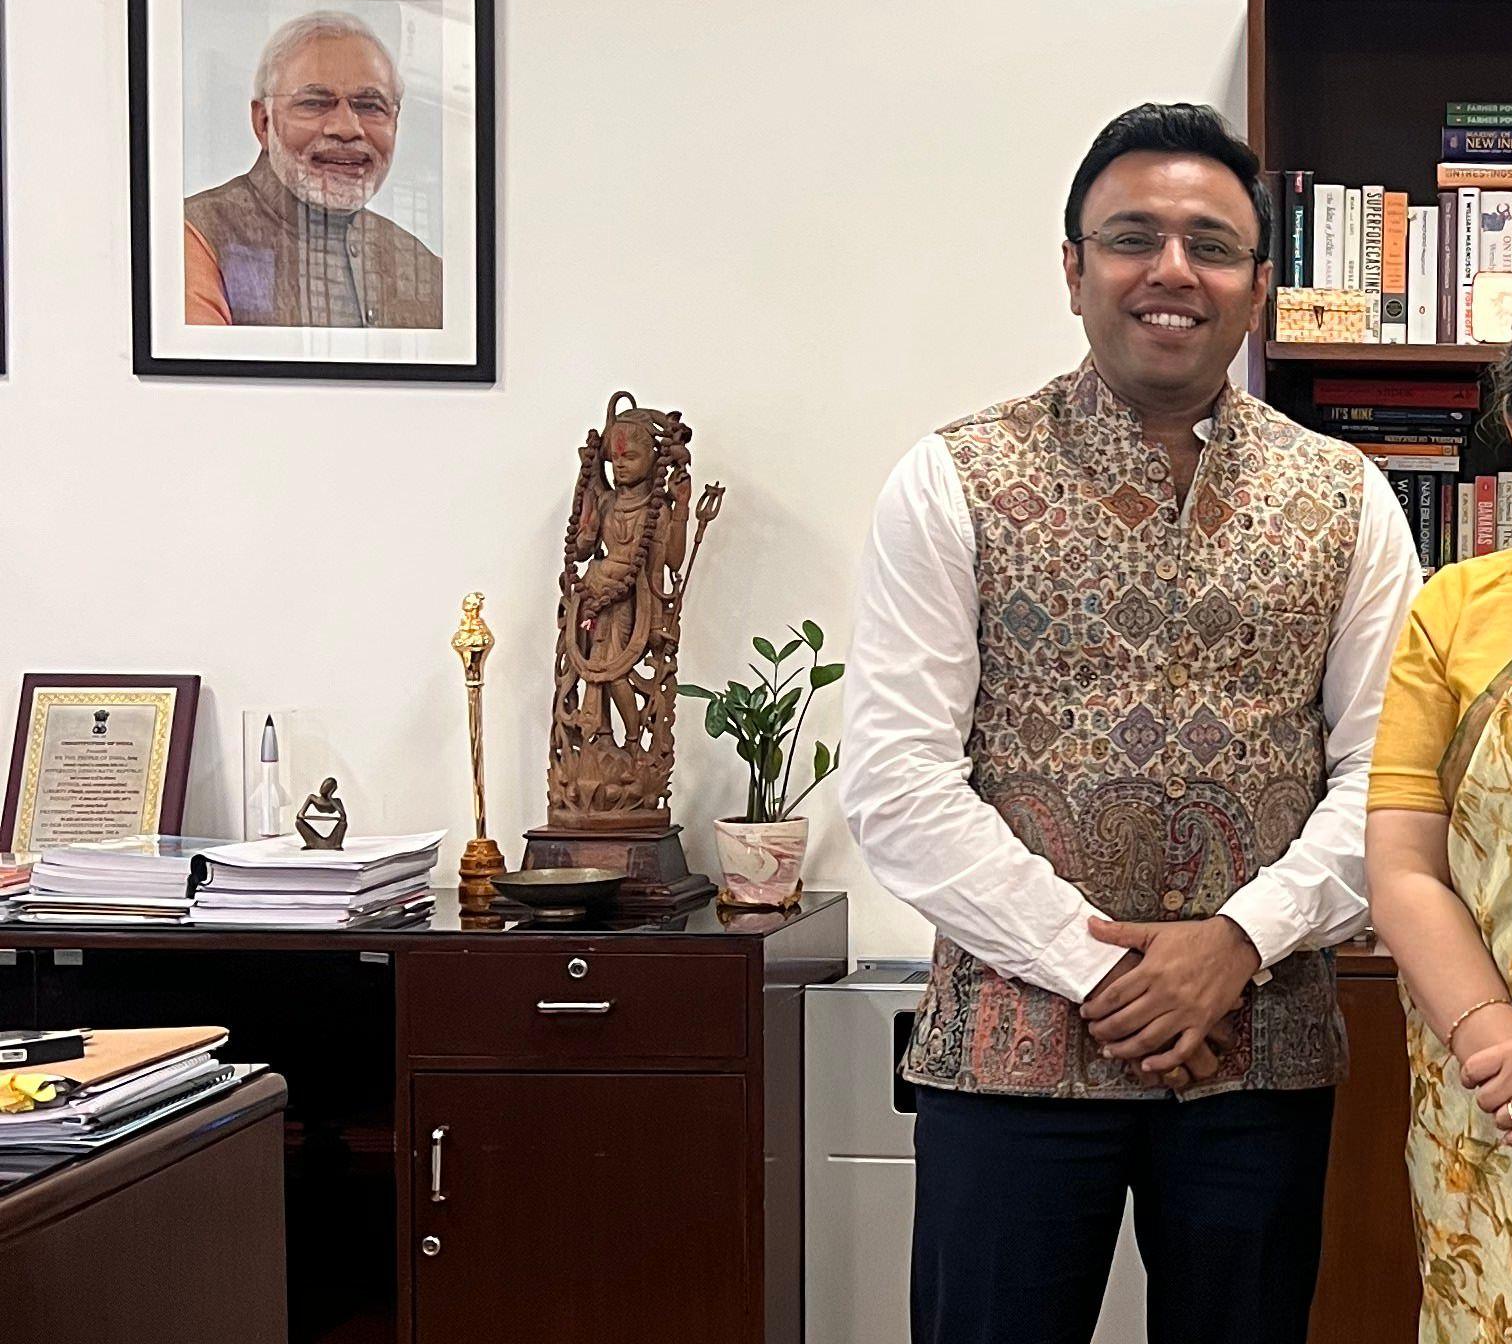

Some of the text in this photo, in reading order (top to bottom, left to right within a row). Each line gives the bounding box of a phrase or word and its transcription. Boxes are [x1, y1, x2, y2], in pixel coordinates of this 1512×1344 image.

[1467, 116, 1497, 124] FARMER
[1466, 138, 1493, 149] NEW
[1364, 192, 1382, 294] SUPERFORECASTING
[1503, 236, 1512, 251] ON
[1331, 409, 1374, 421] IT'S MINE
[1420, 481, 1430, 506] NAZI
[1477, 501, 1493, 545] BANARAS
[1502, 529, 1512, 547] The
